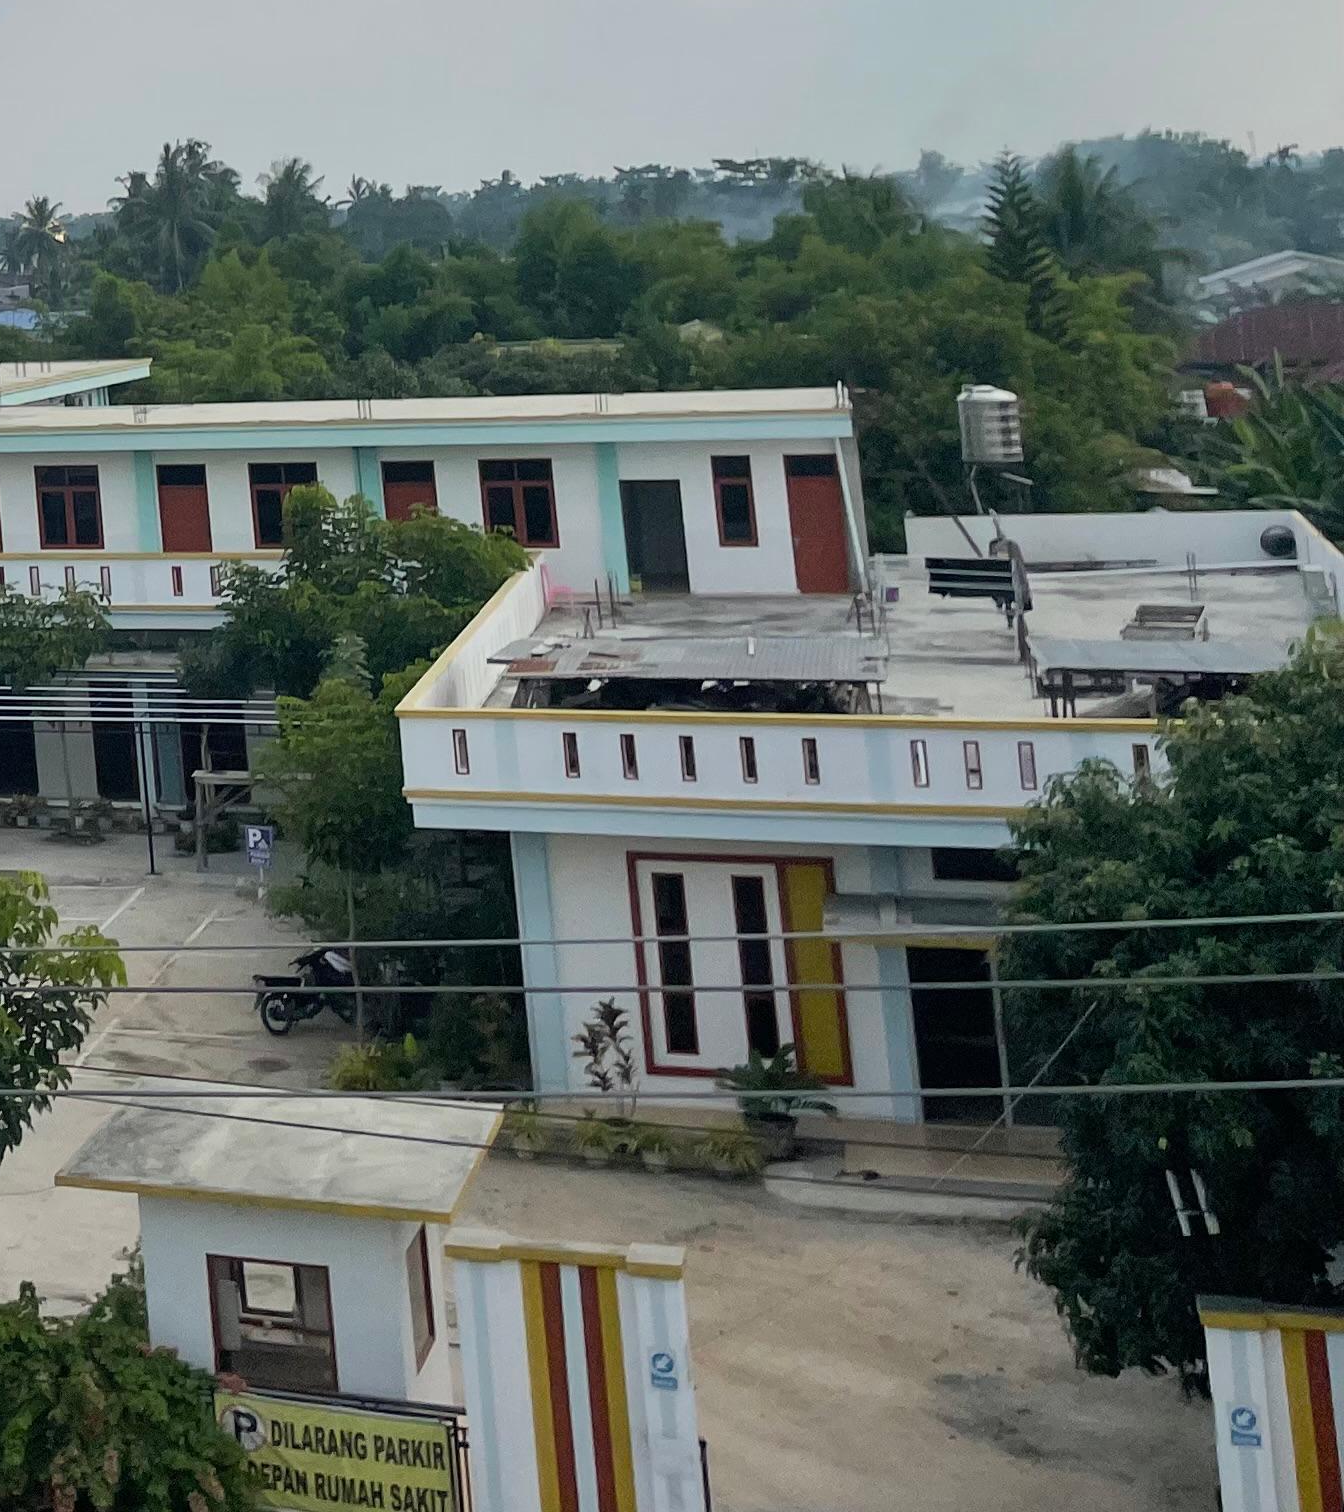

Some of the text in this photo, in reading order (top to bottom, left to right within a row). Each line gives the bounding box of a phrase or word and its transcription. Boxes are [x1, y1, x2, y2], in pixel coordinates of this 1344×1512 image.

[270, 1419, 368, 1461] DILARANG
[373, 1434, 446, 1471] PARKIR
[314, 1472, 385, 1509] RUMAH
[390, 1483, 449, 1512] SAKIT
